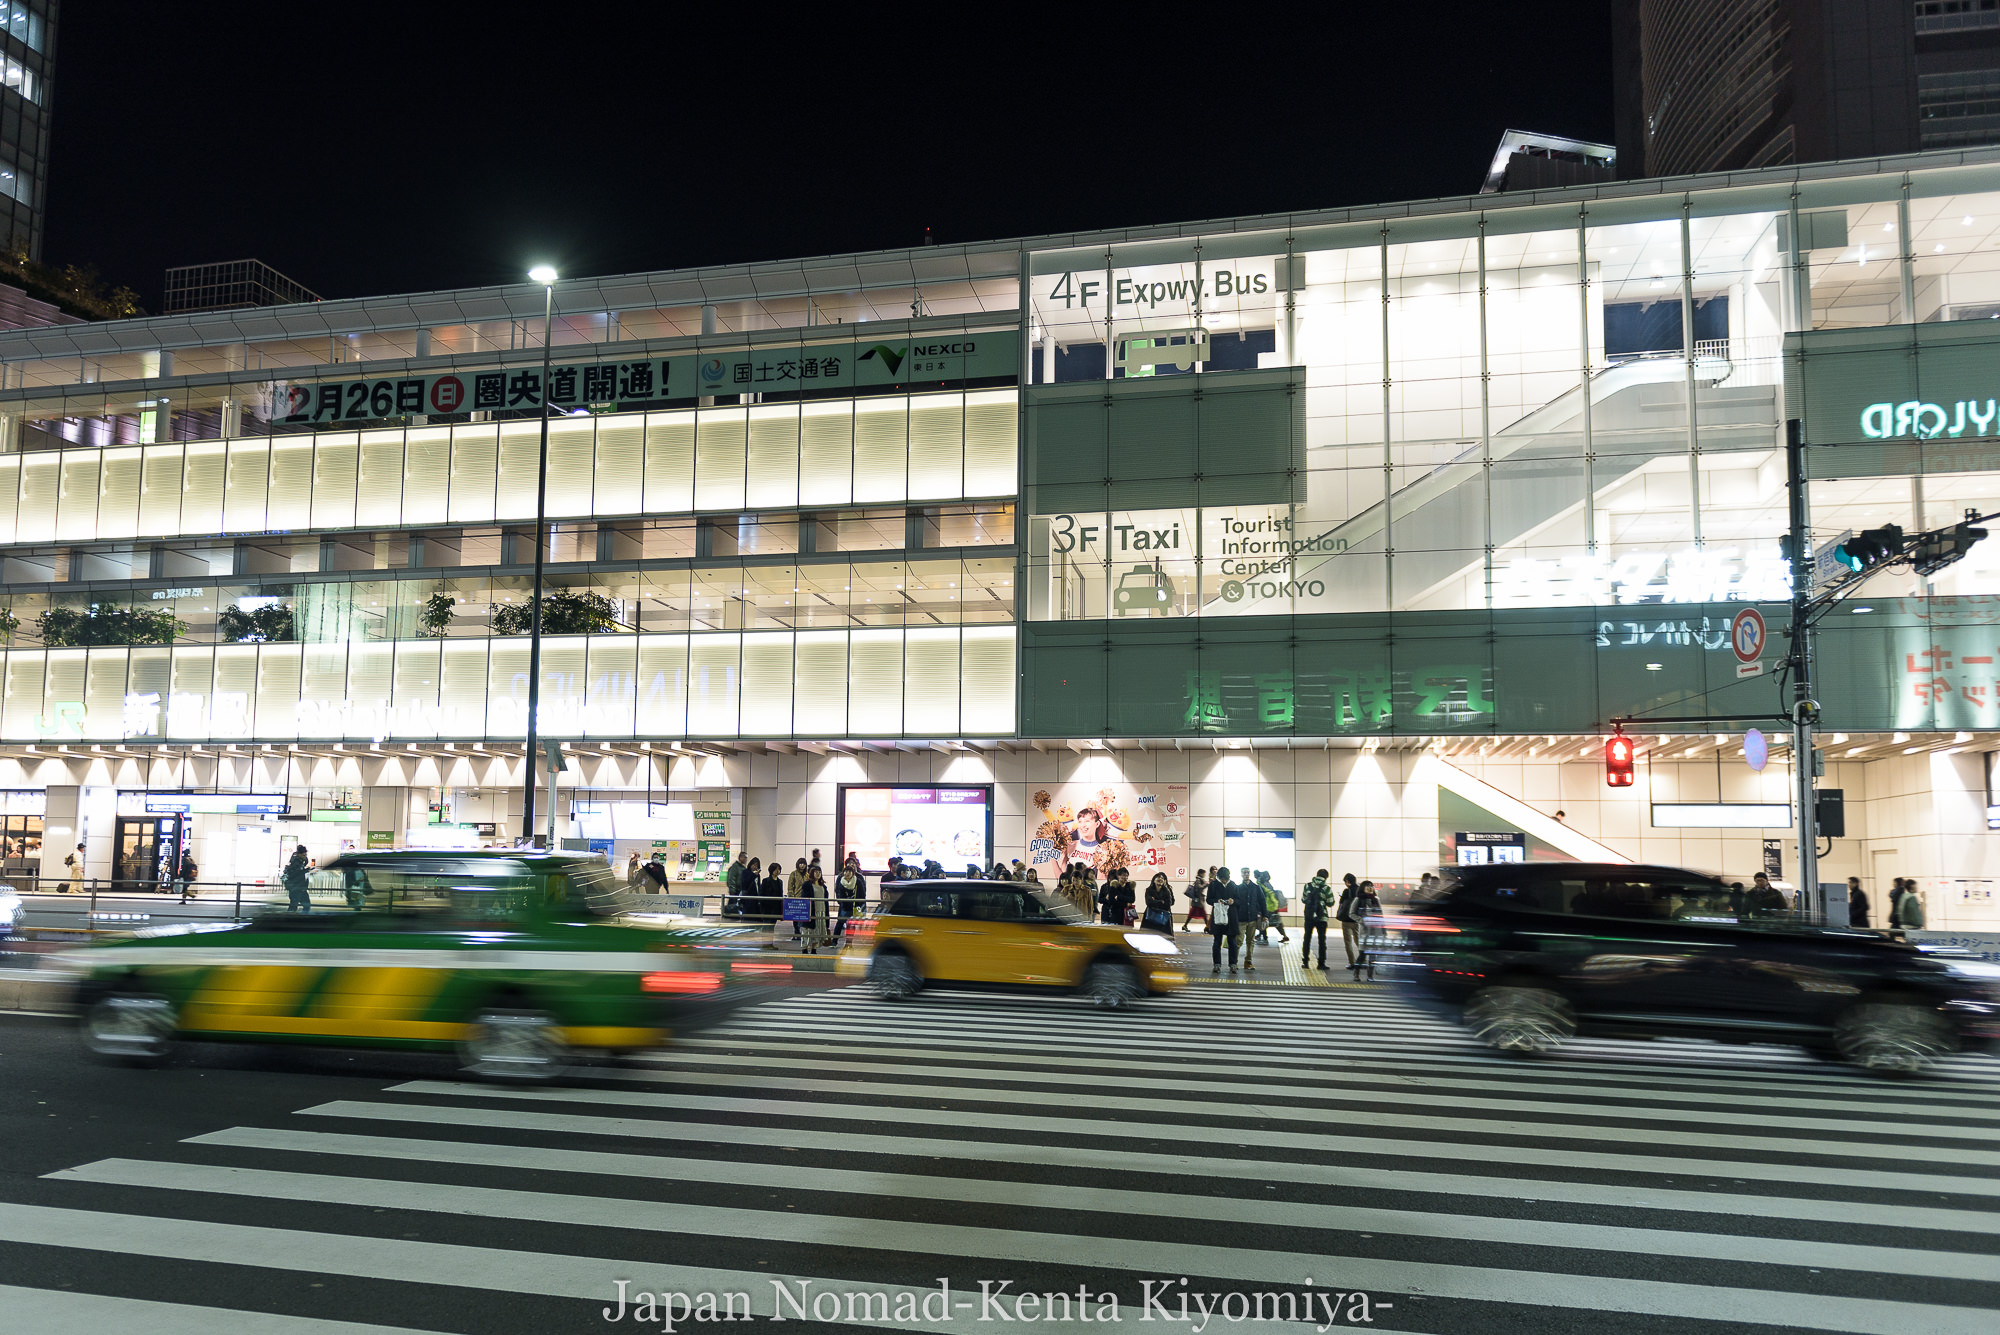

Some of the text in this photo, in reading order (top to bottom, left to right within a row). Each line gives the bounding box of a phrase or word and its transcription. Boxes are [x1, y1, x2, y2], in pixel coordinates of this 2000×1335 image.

[1049, 270, 1268, 310] 4F Expwy. Bus
[914, 342, 975, 357] NEXCO
[733, 357, 841, 384] 国土交通省
[914, 361, 946, 372] 東日本
[285, 380, 425, 422] 2月26日
[474, 361, 669, 409] 圏央道開通!
[1053, 514, 1180, 554] 3F Taxi
[1220, 515, 1293, 534] Tourist
[1221, 533, 1349, 555] Information
[1220, 559, 1291, 575] Center
[1247, 580, 1325, 599] TOKYO
[33, 701, 87, 735] JR
[1138, 796, 1155, 804] AOKI
